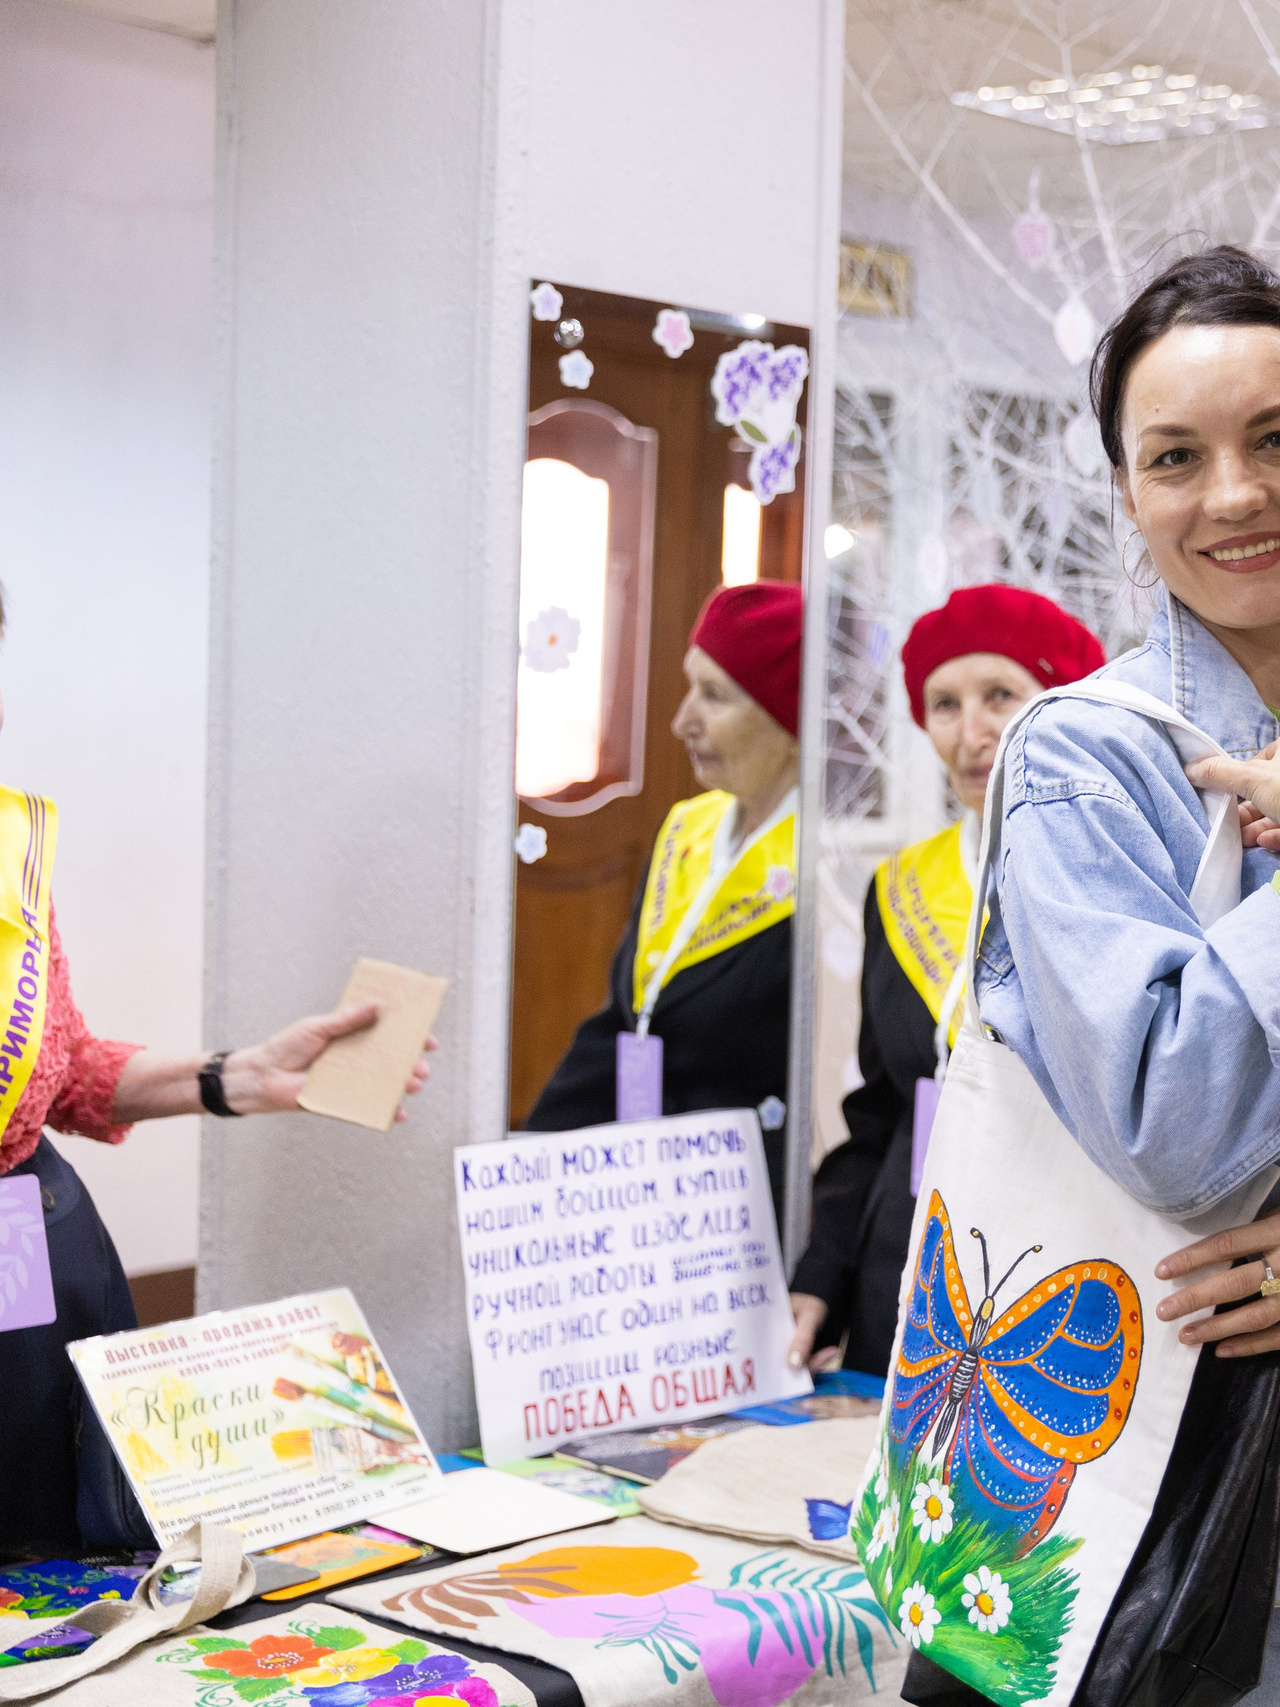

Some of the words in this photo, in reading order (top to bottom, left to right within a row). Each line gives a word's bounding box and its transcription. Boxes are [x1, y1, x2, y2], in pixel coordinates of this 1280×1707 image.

[0, 906, 41, 1106] РИМОРЬЯ
[104, 1334, 188, 1364] Выставка
[202, 1317, 273, 1342] продажа
[277, 1305, 321, 1327] работ
[111, 1384, 262, 1439] «Краски
[524, 1383, 637, 1441] ПОБЕДА
[652, 1359, 757, 1412] ОБЩАЯ
[191, 1408, 285, 1469] души»
